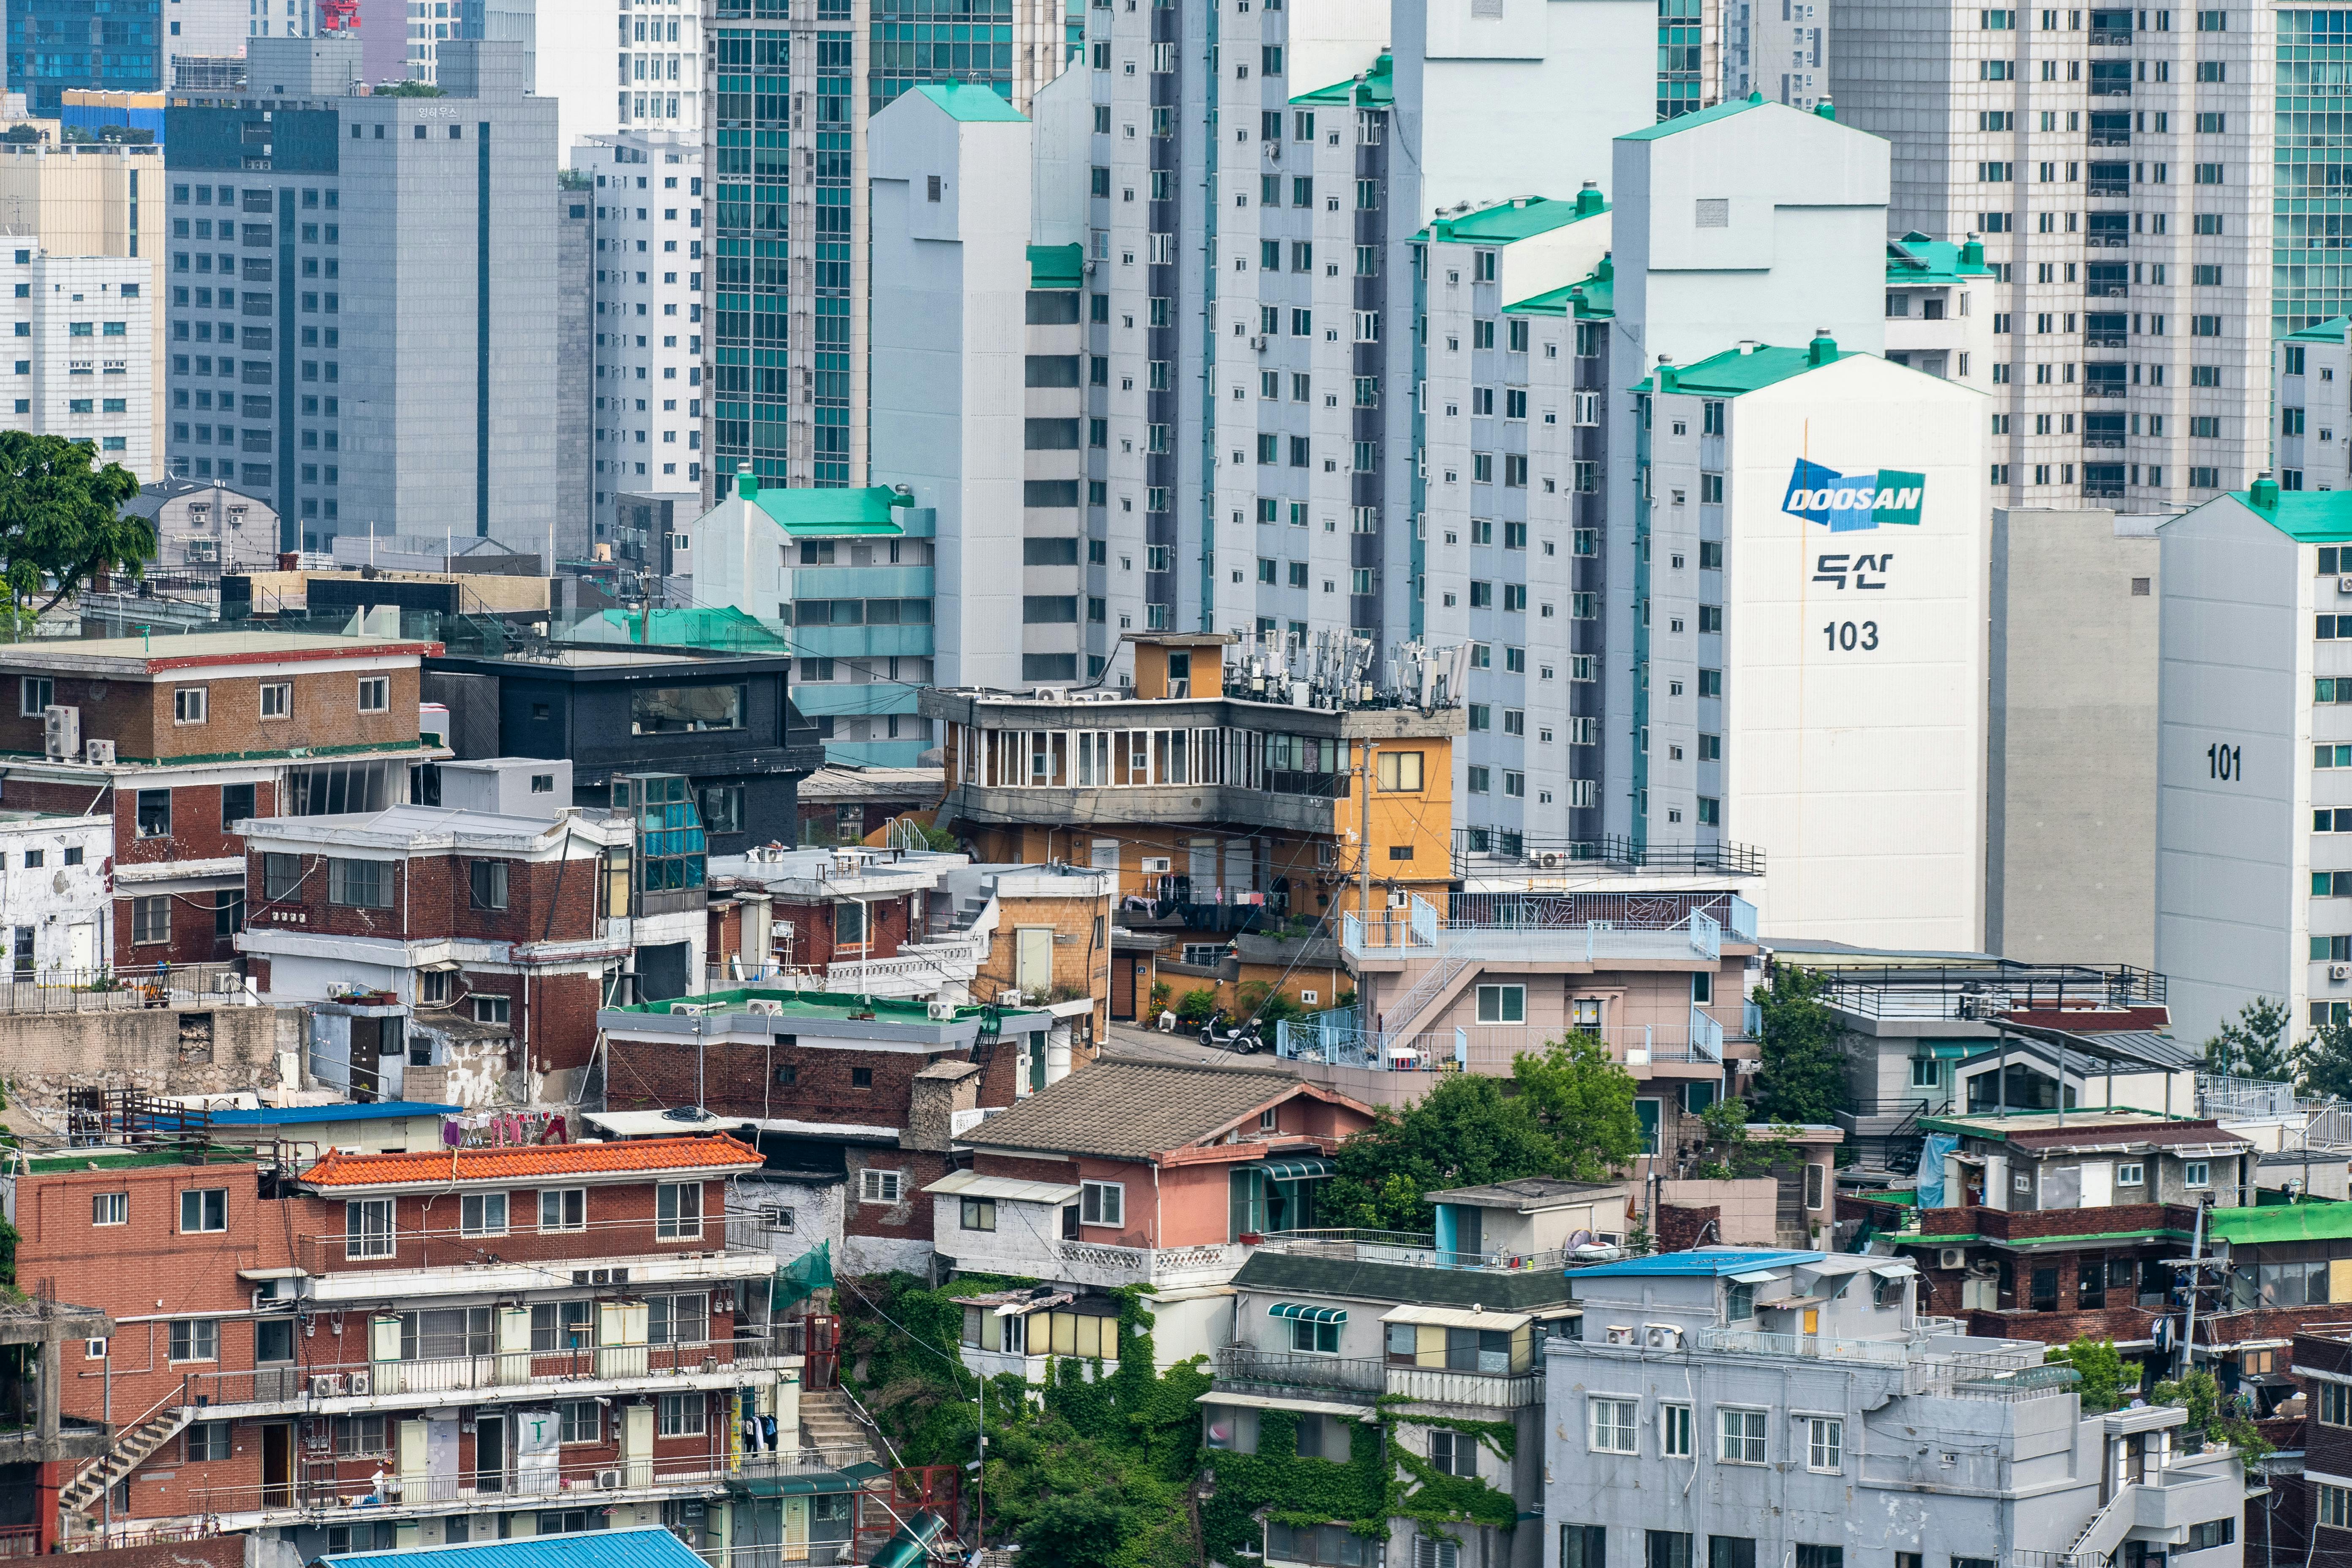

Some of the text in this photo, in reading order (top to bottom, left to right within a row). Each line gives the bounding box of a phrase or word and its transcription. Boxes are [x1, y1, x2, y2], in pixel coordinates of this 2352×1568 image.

[419, 107, 457, 118] 영하우스
[1786, 487, 1922, 511] DOOSAN
[1824, 621, 1879, 651] 103
[2208, 743, 2240, 781] 101
